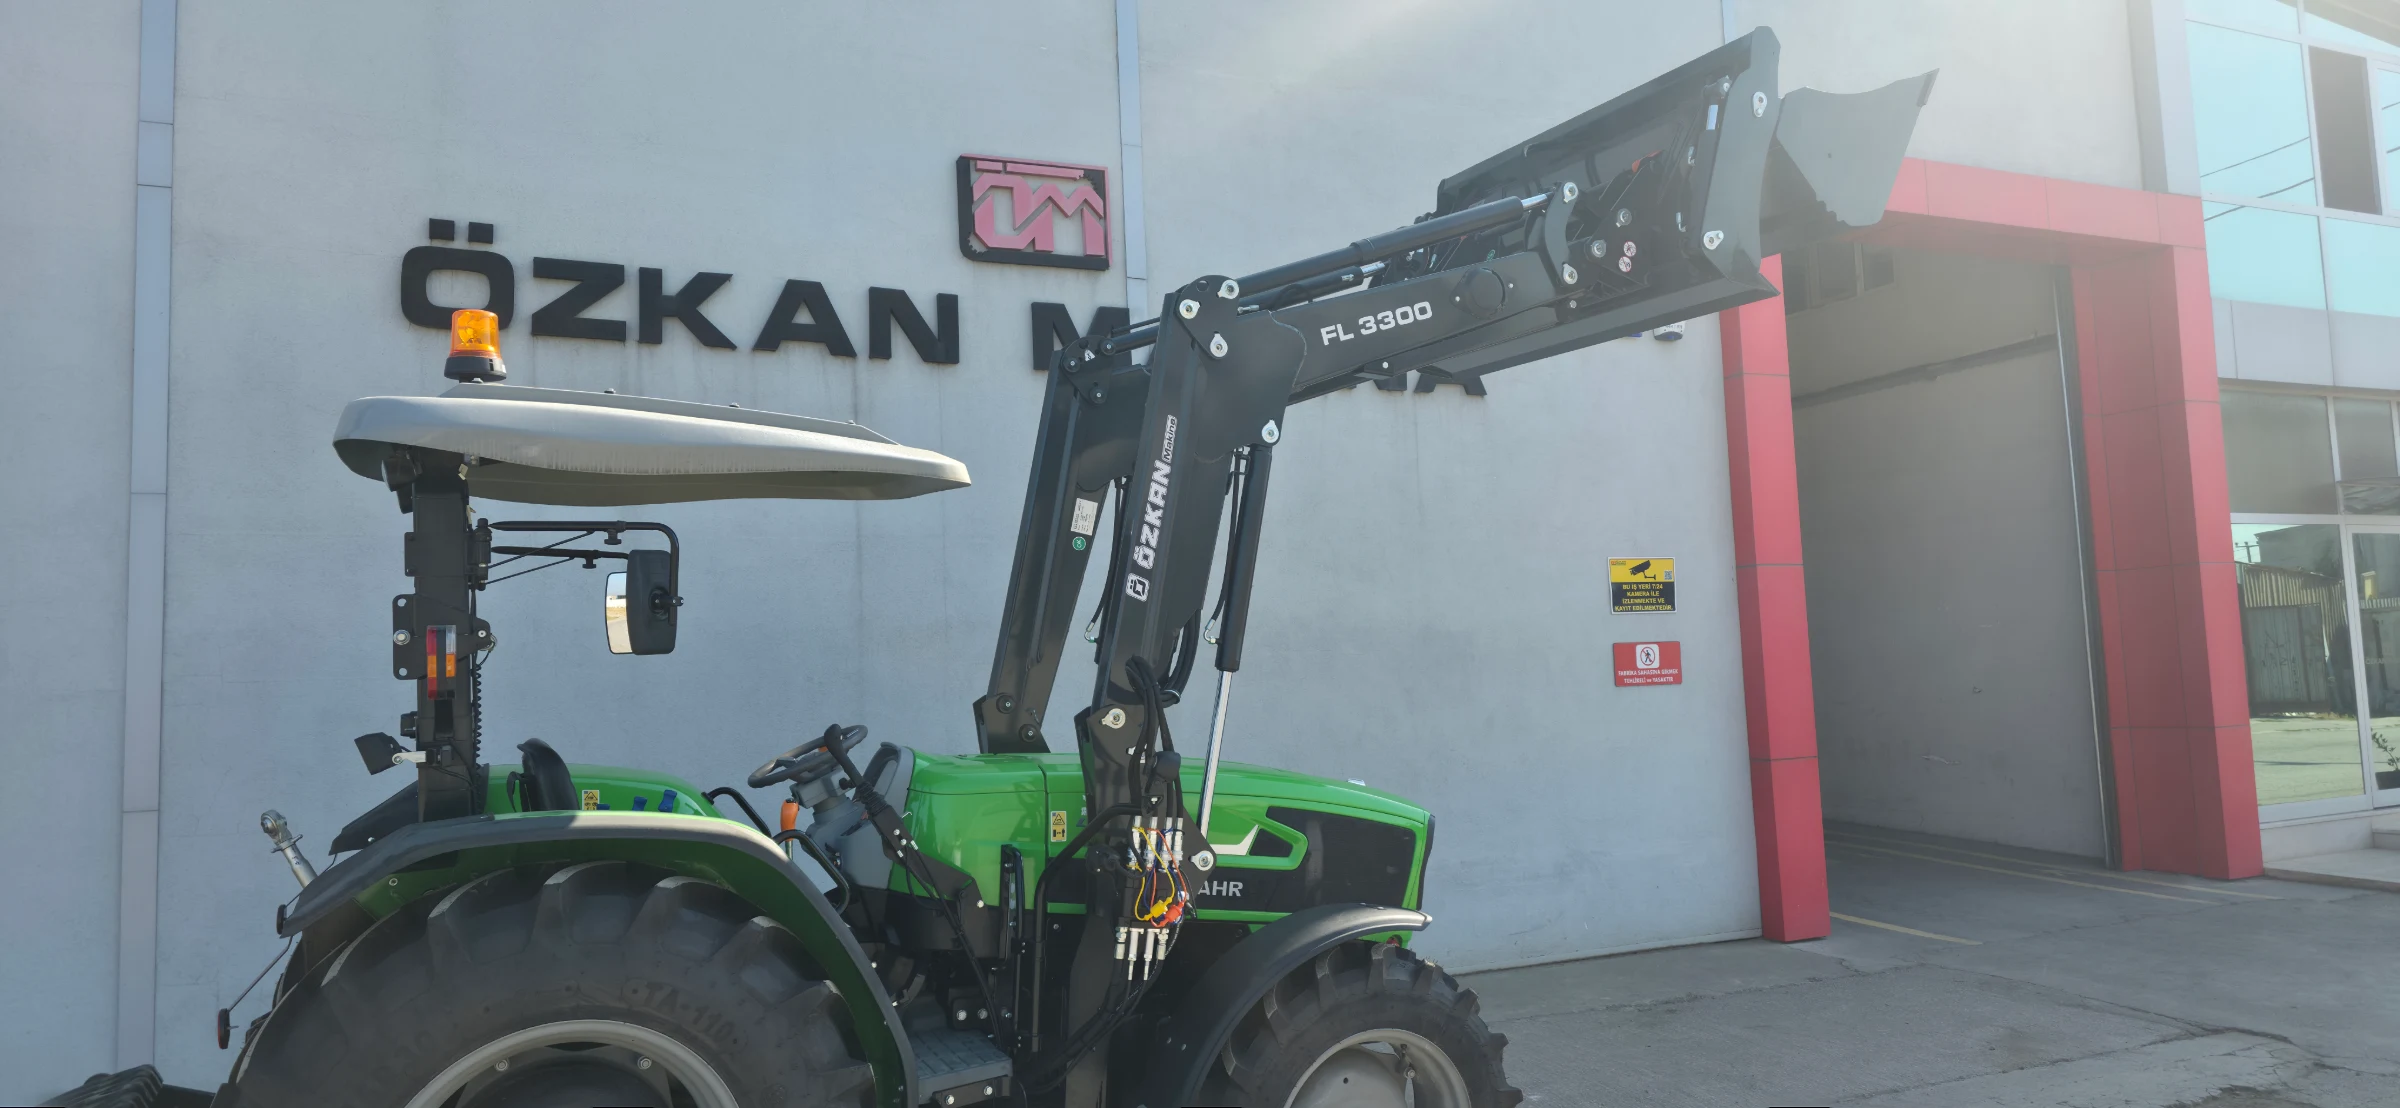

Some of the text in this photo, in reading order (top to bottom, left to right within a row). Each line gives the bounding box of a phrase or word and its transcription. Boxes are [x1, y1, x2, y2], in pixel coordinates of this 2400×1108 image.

[401, 217, 961, 365] ÖZKAN
[1320, 301, 1433, 346] FL 3300
[1133, 459, 1172, 569] ÖZKAN
[1163, 417, 1177, 461] Makina
[1197, 880, 1244, 897] AHR
